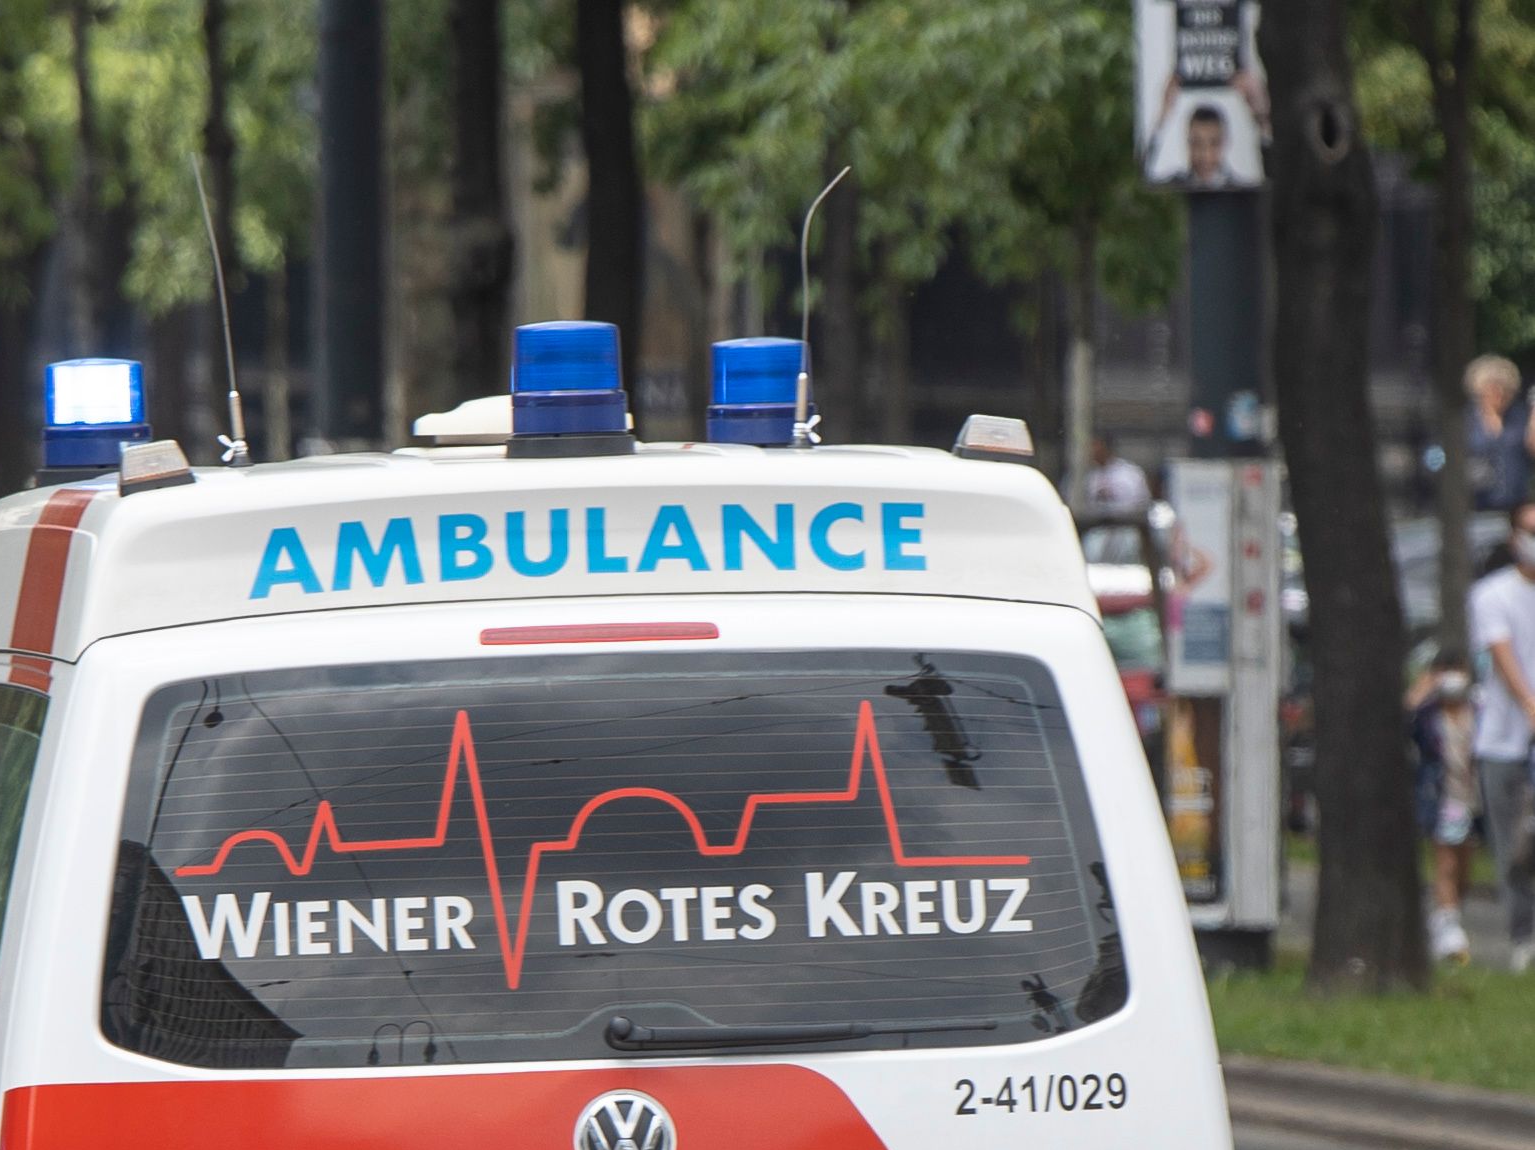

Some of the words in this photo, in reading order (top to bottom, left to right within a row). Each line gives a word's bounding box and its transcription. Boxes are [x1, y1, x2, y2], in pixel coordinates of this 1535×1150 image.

[248, 502, 927, 600] AMBULANCE
[181, 892, 476, 960] WIENER
[556, 879, 777, 946] ROTES
[805, 871, 1033, 938] KREUZ
[955, 1073, 1127, 1115] 2-41/029
